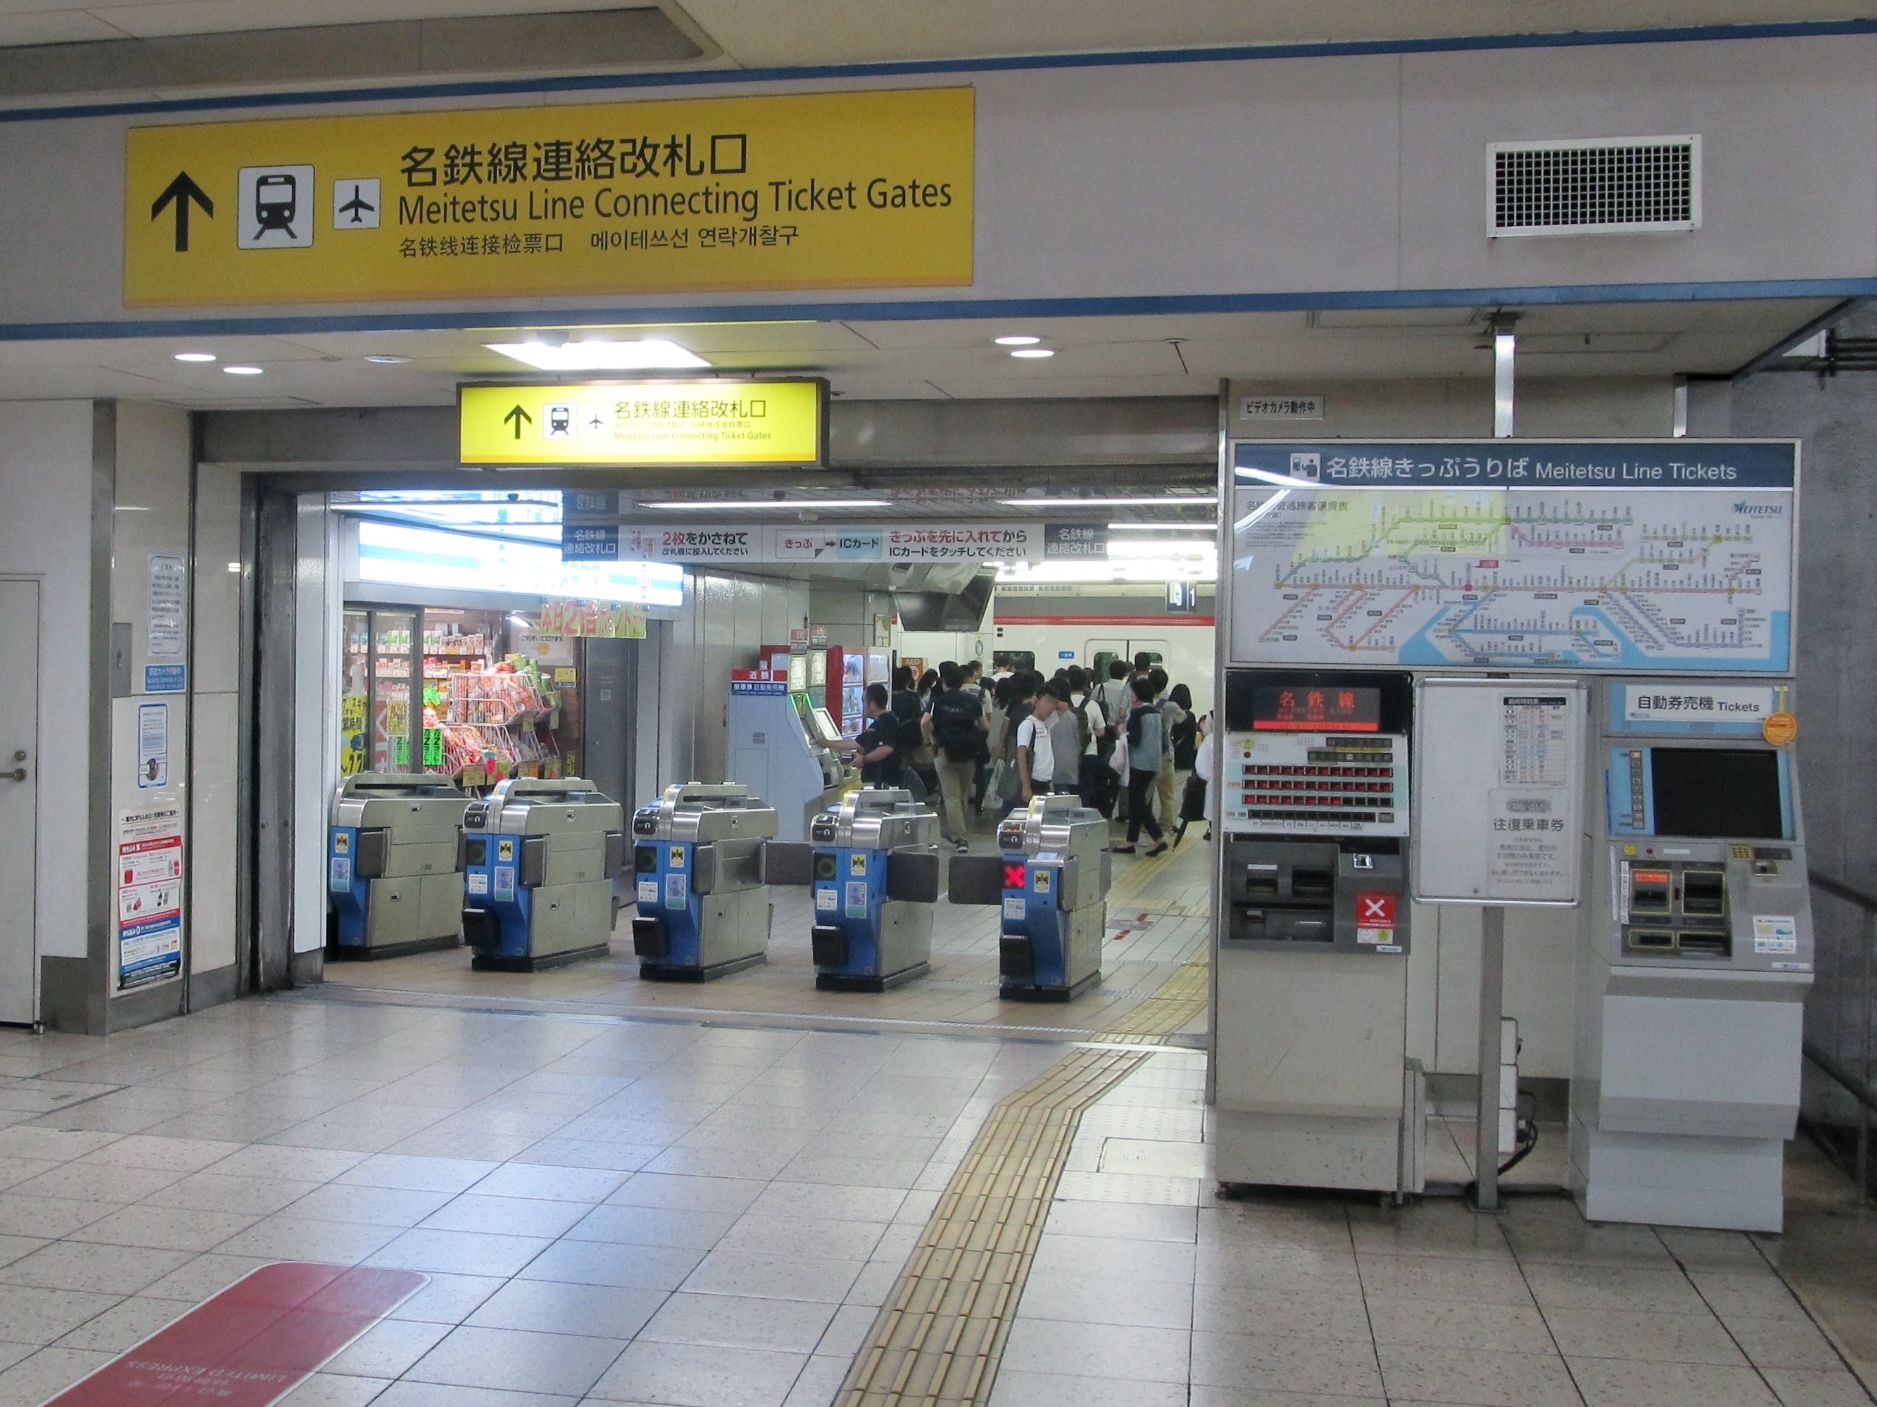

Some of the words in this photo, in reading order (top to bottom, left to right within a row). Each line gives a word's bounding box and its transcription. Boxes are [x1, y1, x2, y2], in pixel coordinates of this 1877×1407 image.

[400, 134, 747, 188] 名鉄線連絡改札口
[399, 193, 517, 225] Meitetsu
[529, 189, 584, 220] Line
[595, 182, 758, 222] Connecting
[768, 178, 856, 212] Ticket
[867, 177, 952, 208] Gates
[399, 233, 563, 258] 名铁线连接检票口
[591, 228, 689, 250] 메이테쓰선
[698, 225, 799, 247] 연락개찰구
[614, 400, 766, 419] 名鉄線連絡改札口
[652, 432, 669, 440] Line
[671, 431, 719, 442] Connecting
[721, 431, 745, 440] Ticket
[747, 431, 771, 440] Gates
[1326, 457, 1529, 480] 名鉄線きっぷうりば
[1535, 461, 1616, 480] Meitetsu
[1623, 461, 1663, 479] Line
[1669, 461, 1738, 480] Tickets
[662, 532, 748, 546] 2枚をかさねて
[840, 538, 880, 549] ICカード
[1637, 695, 1714, 711] 自動券売機
[1718, 701, 1760, 712] Tickets
[1493, 818, 1565, 832] 往復乗車券
